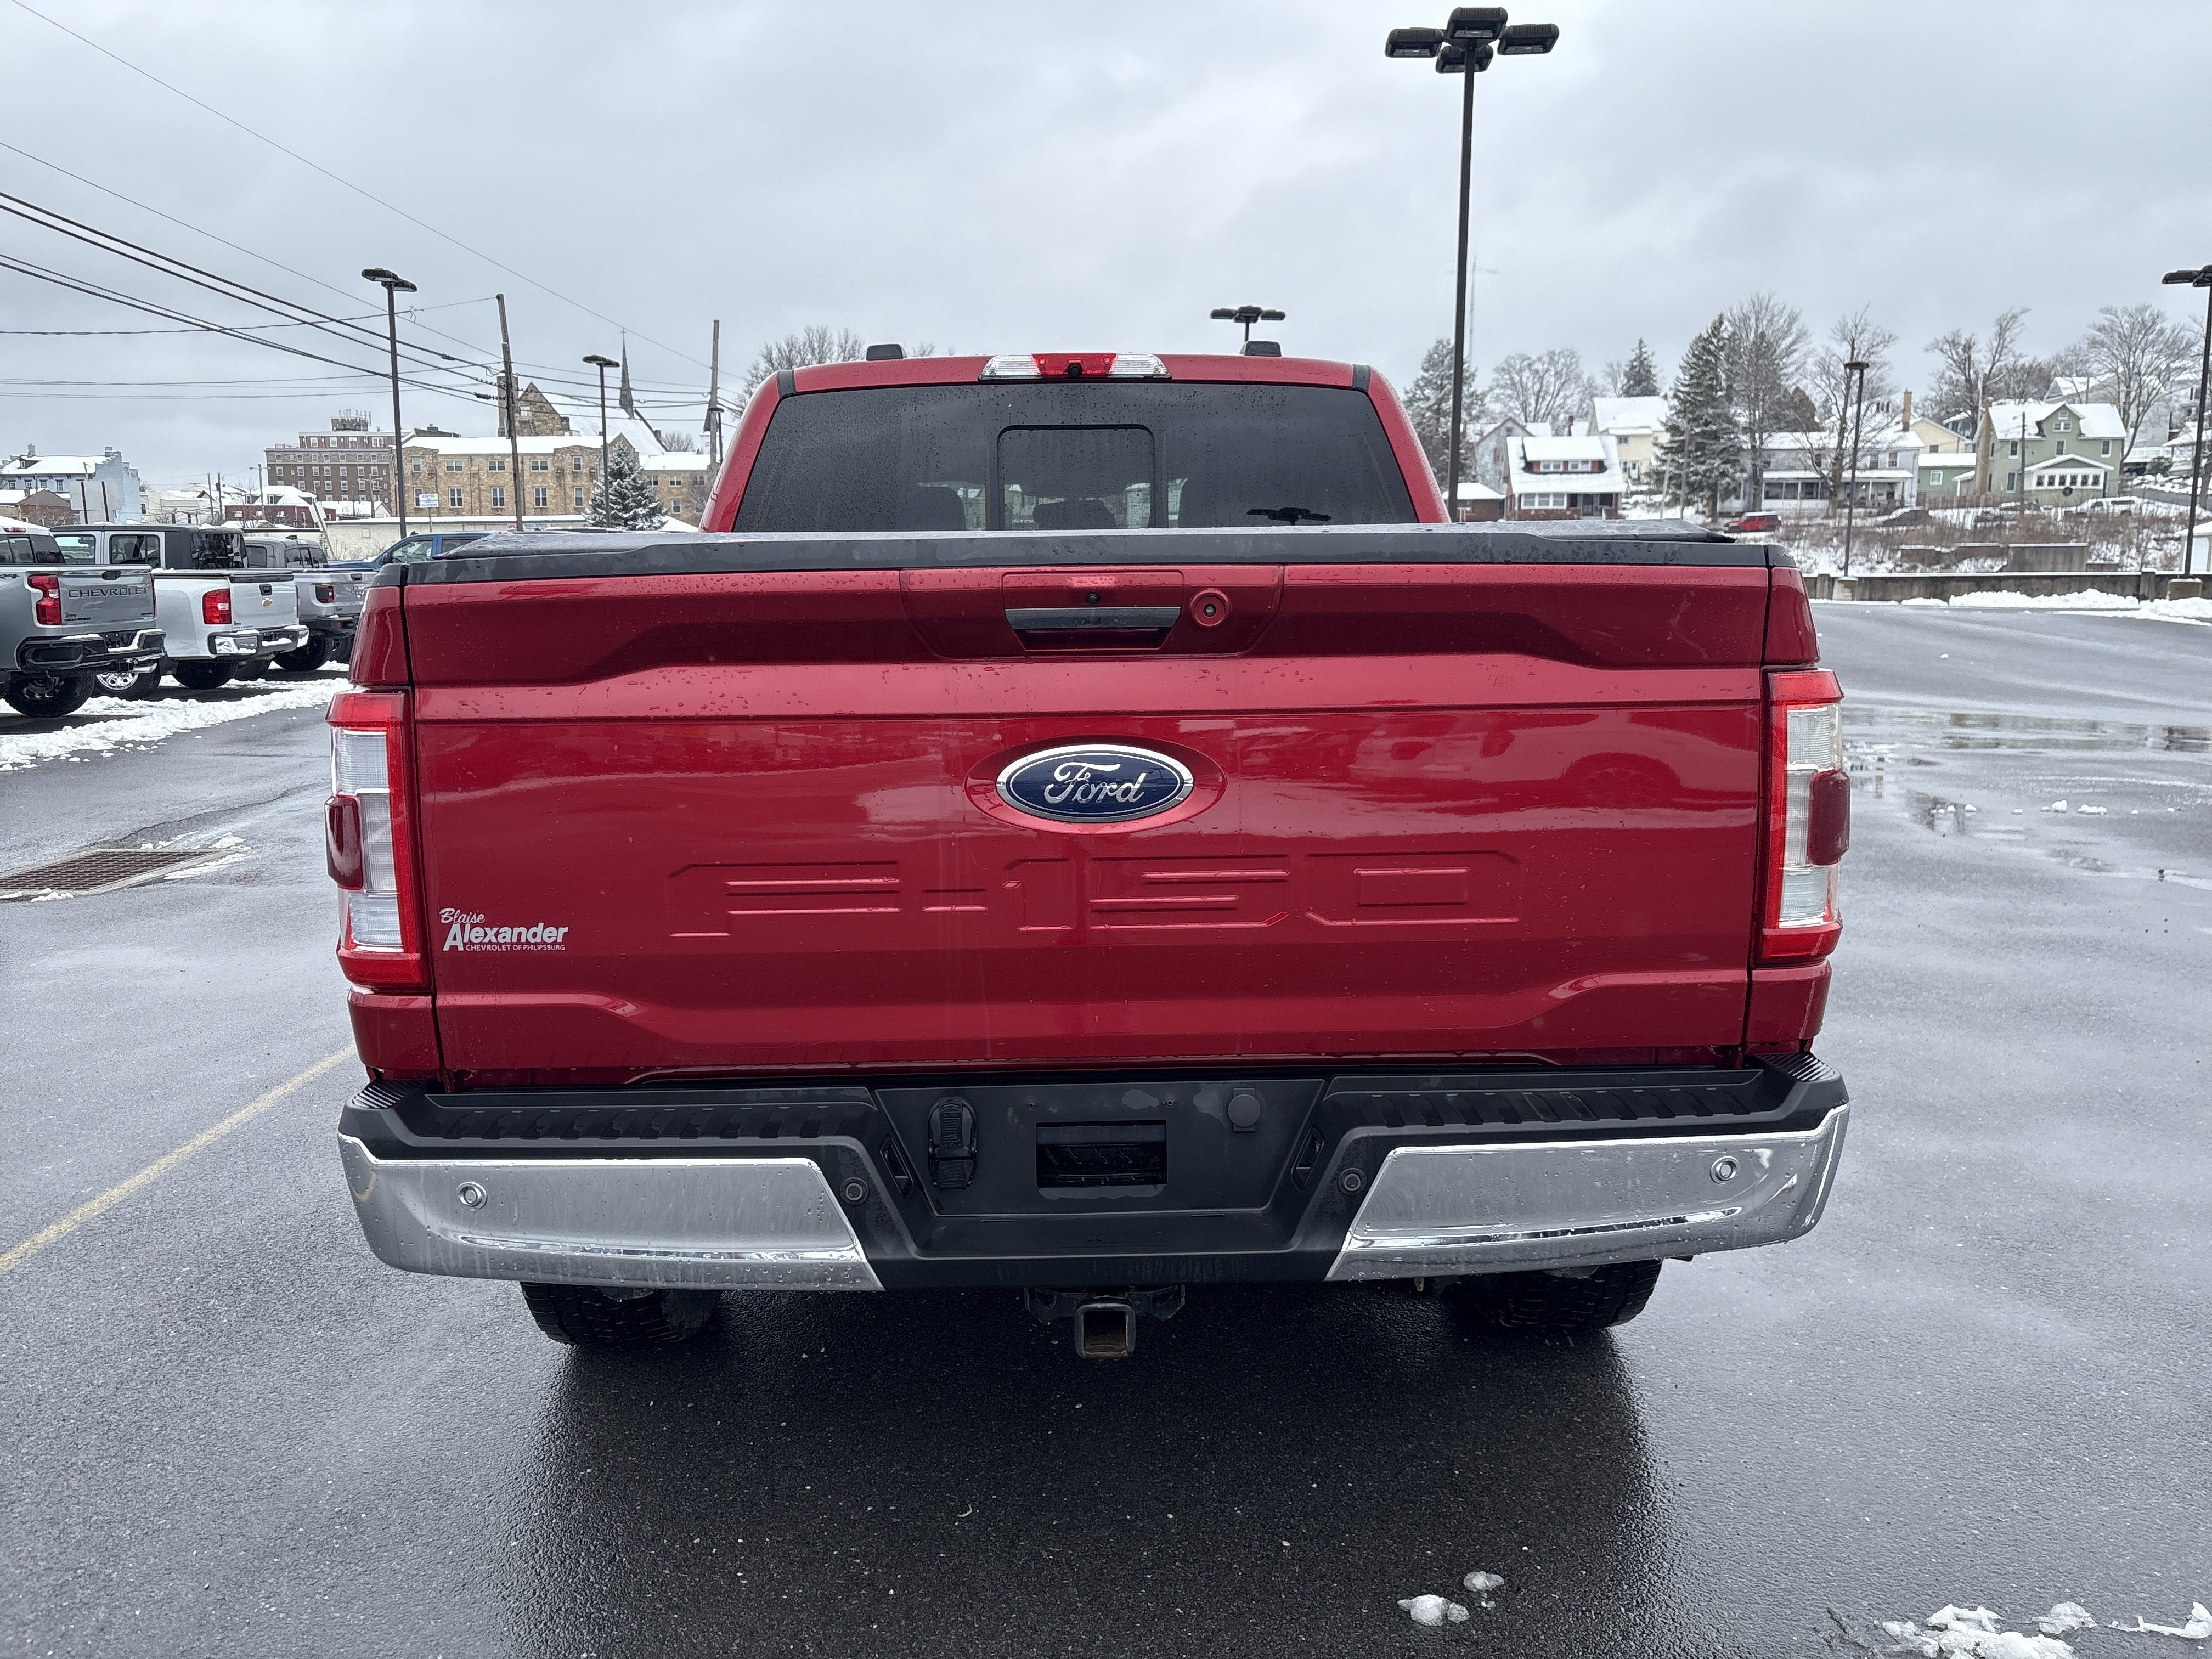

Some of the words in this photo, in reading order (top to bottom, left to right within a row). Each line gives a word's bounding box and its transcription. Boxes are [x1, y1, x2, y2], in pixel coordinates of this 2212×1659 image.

[69, 587, 147, 598] CHEVROLET
[1043, 761, 1147, 804] Ford
[668, 849, 1520, 938] F-150
[439, 907, 486, 924] Blaise
[442, 922, 568, 951] Alexander
